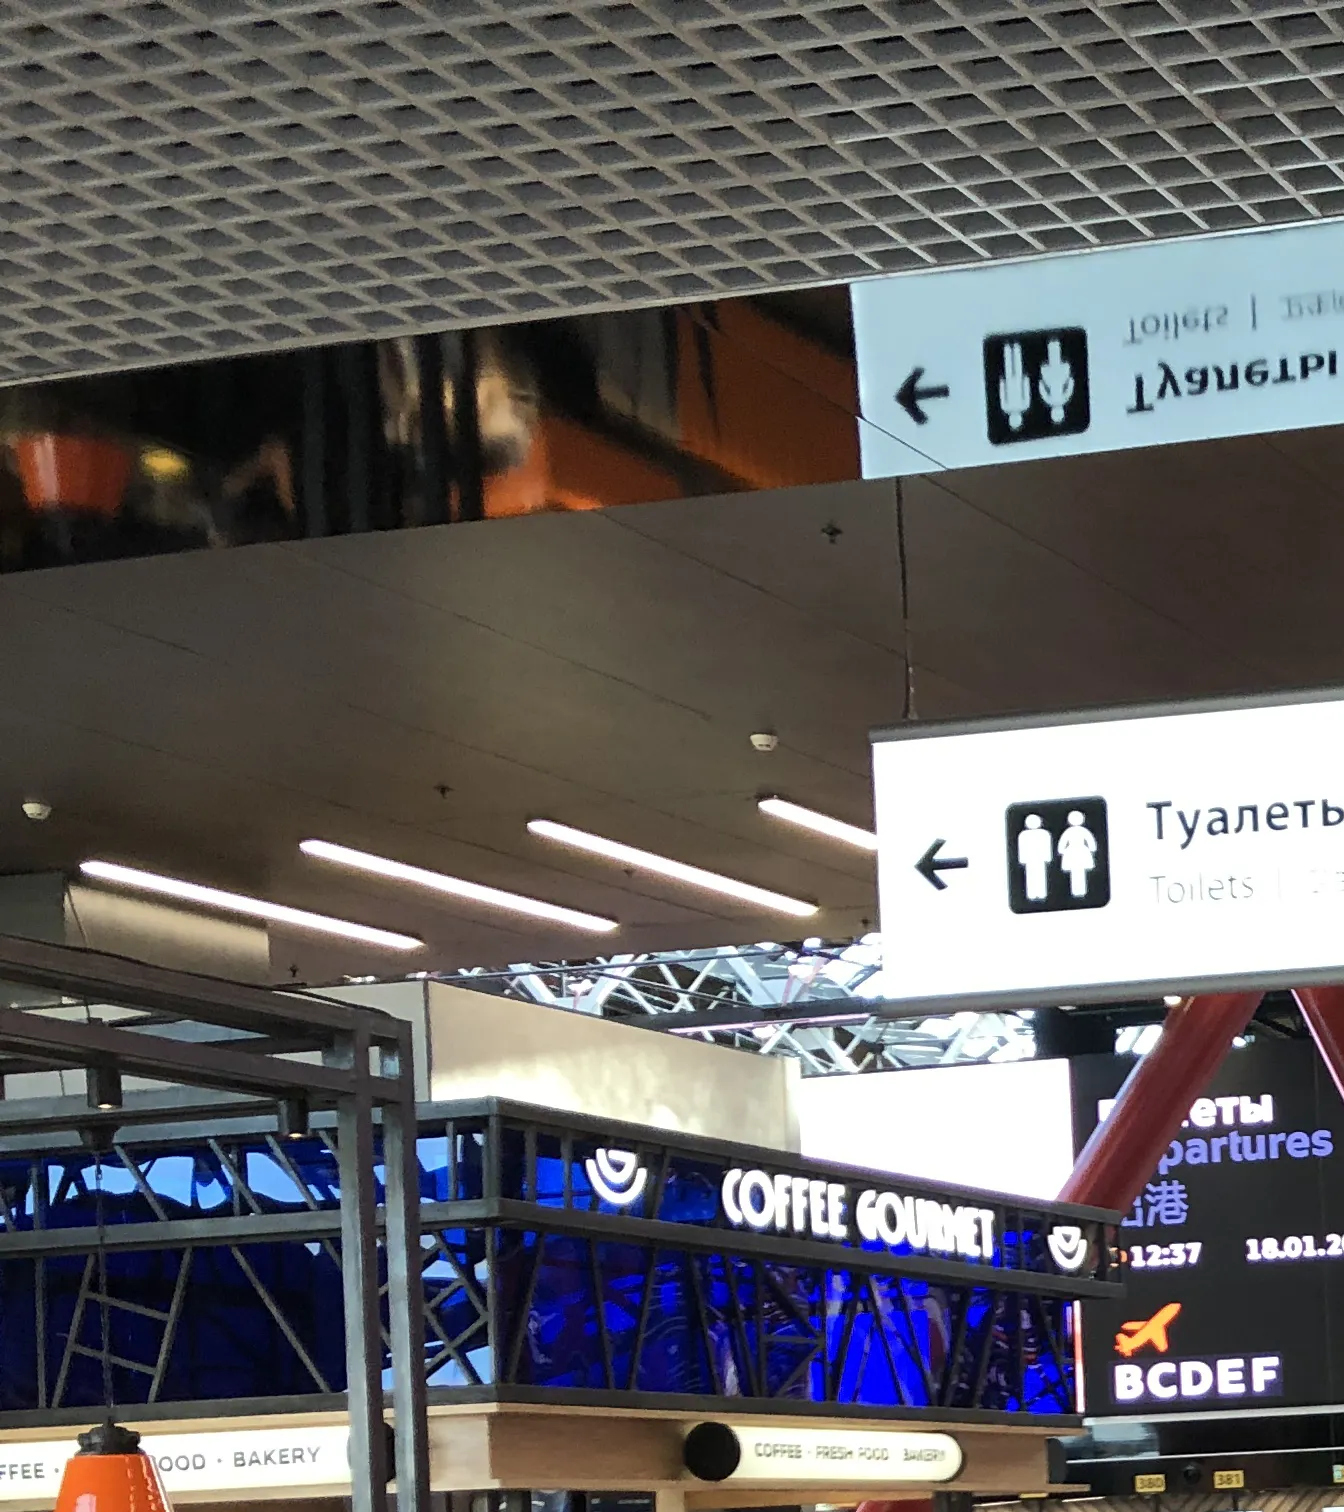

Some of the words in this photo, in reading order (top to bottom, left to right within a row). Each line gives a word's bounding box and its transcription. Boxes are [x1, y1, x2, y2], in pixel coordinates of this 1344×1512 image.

[1149, 871, 1255, 908] Toilets
[1158, 1130, 1334, 1174] partures
[722, 1168, 847, 1239] COFFEE
[856, 1189, 997, 1259] GOURMET
[1130, 1242, 1202, 1269] 12:37
[1114, 1357, 1280, 1401] BCDEF
[0, 1463, 45, 1480] FFEE
[159, 1453, 206, 1472] OOD
[234, 1447, 321, 1468] BAKERY
[754, 1442, 802, 1459] COFFEE
[816, 1445, 853, 1460] FRESH
